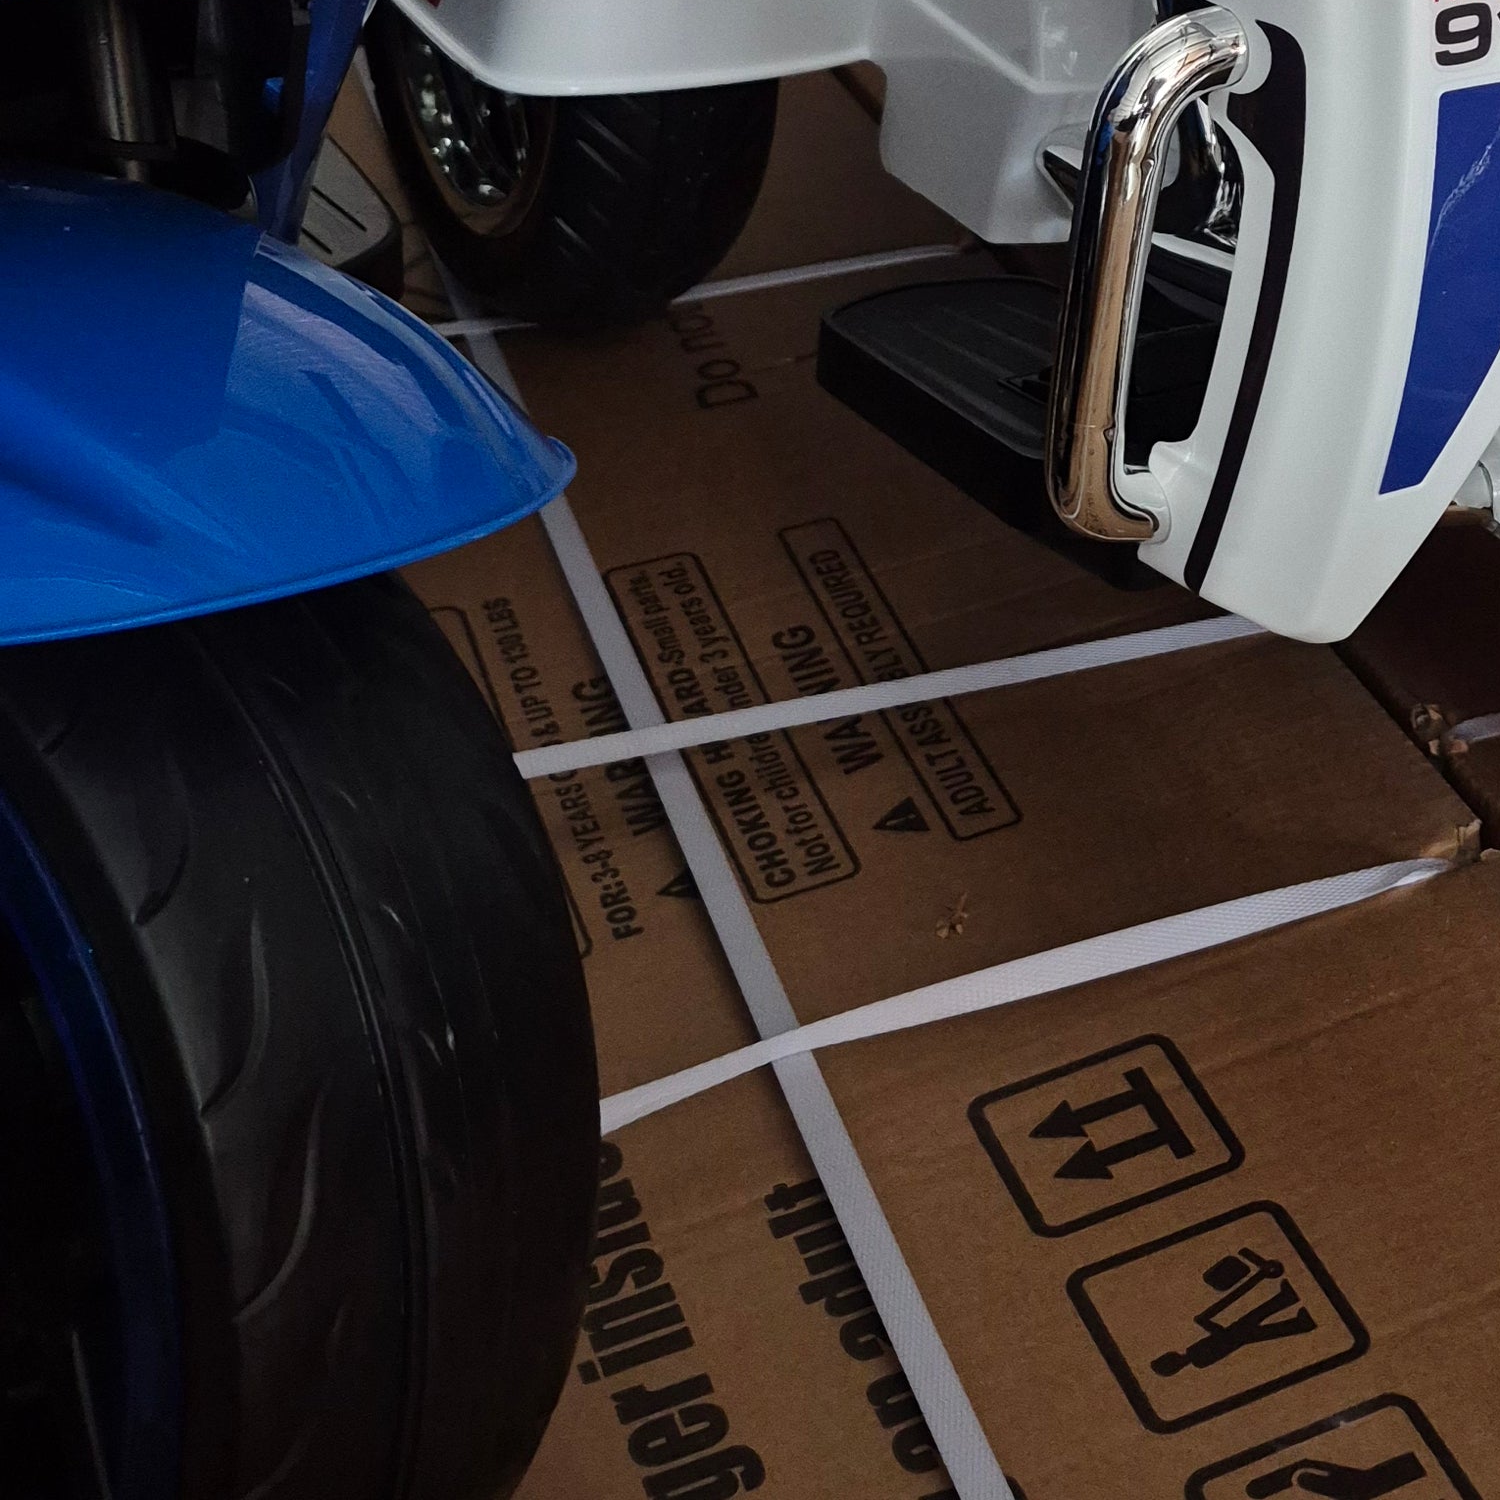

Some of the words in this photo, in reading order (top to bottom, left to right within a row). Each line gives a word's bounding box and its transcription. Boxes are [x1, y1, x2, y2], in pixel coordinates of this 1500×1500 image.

[482, 598, 517, 634] LBS
[679, 596, 730, 649] years
[810, 550, 887, 646] REQUIRED
[510, 667, 541, 695] TO
[699, 648, 728, 664] 3
[520, 695, 552, 722] UP
[713, 666, 751, 708] nder
[773, 625, 884, 775] WANING
[864, 649, 951, 744] ASSBLY
[571, 674, 665, 837] WARING
[744, 731, 799, 800] childre
[924, 750, 995, 815] ADULT
[554, 783, 605, 852] YEARS
[715, 767, 796, 888] CHOKING
[782, 806, 817, 834] for
[795, 833, 841, 876] Not
